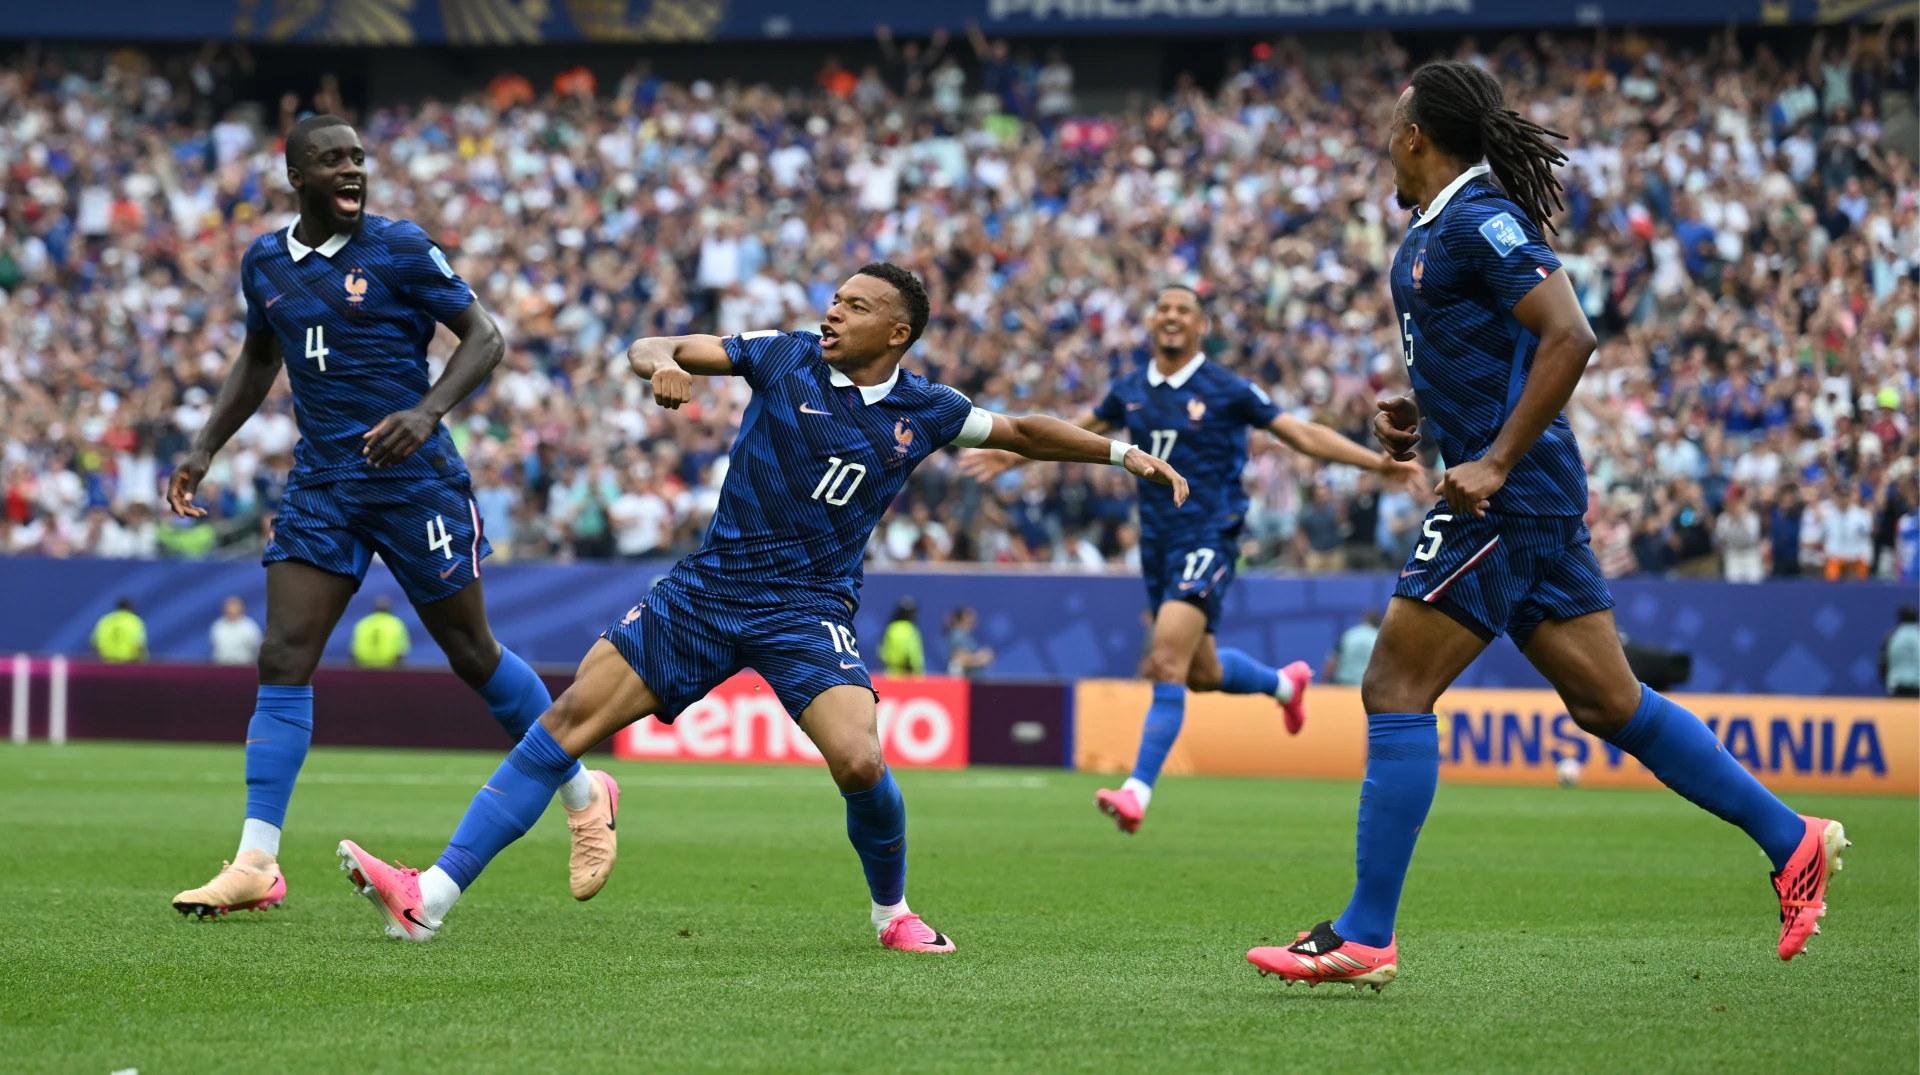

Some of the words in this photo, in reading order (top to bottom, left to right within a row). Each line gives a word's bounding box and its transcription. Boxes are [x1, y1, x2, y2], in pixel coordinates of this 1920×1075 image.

[305, 325, 330, 372] 4
[1403, 312, 1414, 367] 5
[1150, 429, 1178, 461] 17
[811, 456, 866, 506] 10
[426, 514, 453, 560] 4
[1414, 514, 1453, 562] 5
[1183, 548, 1215, 581] 17
[630, 693, 955, 764] Leno
